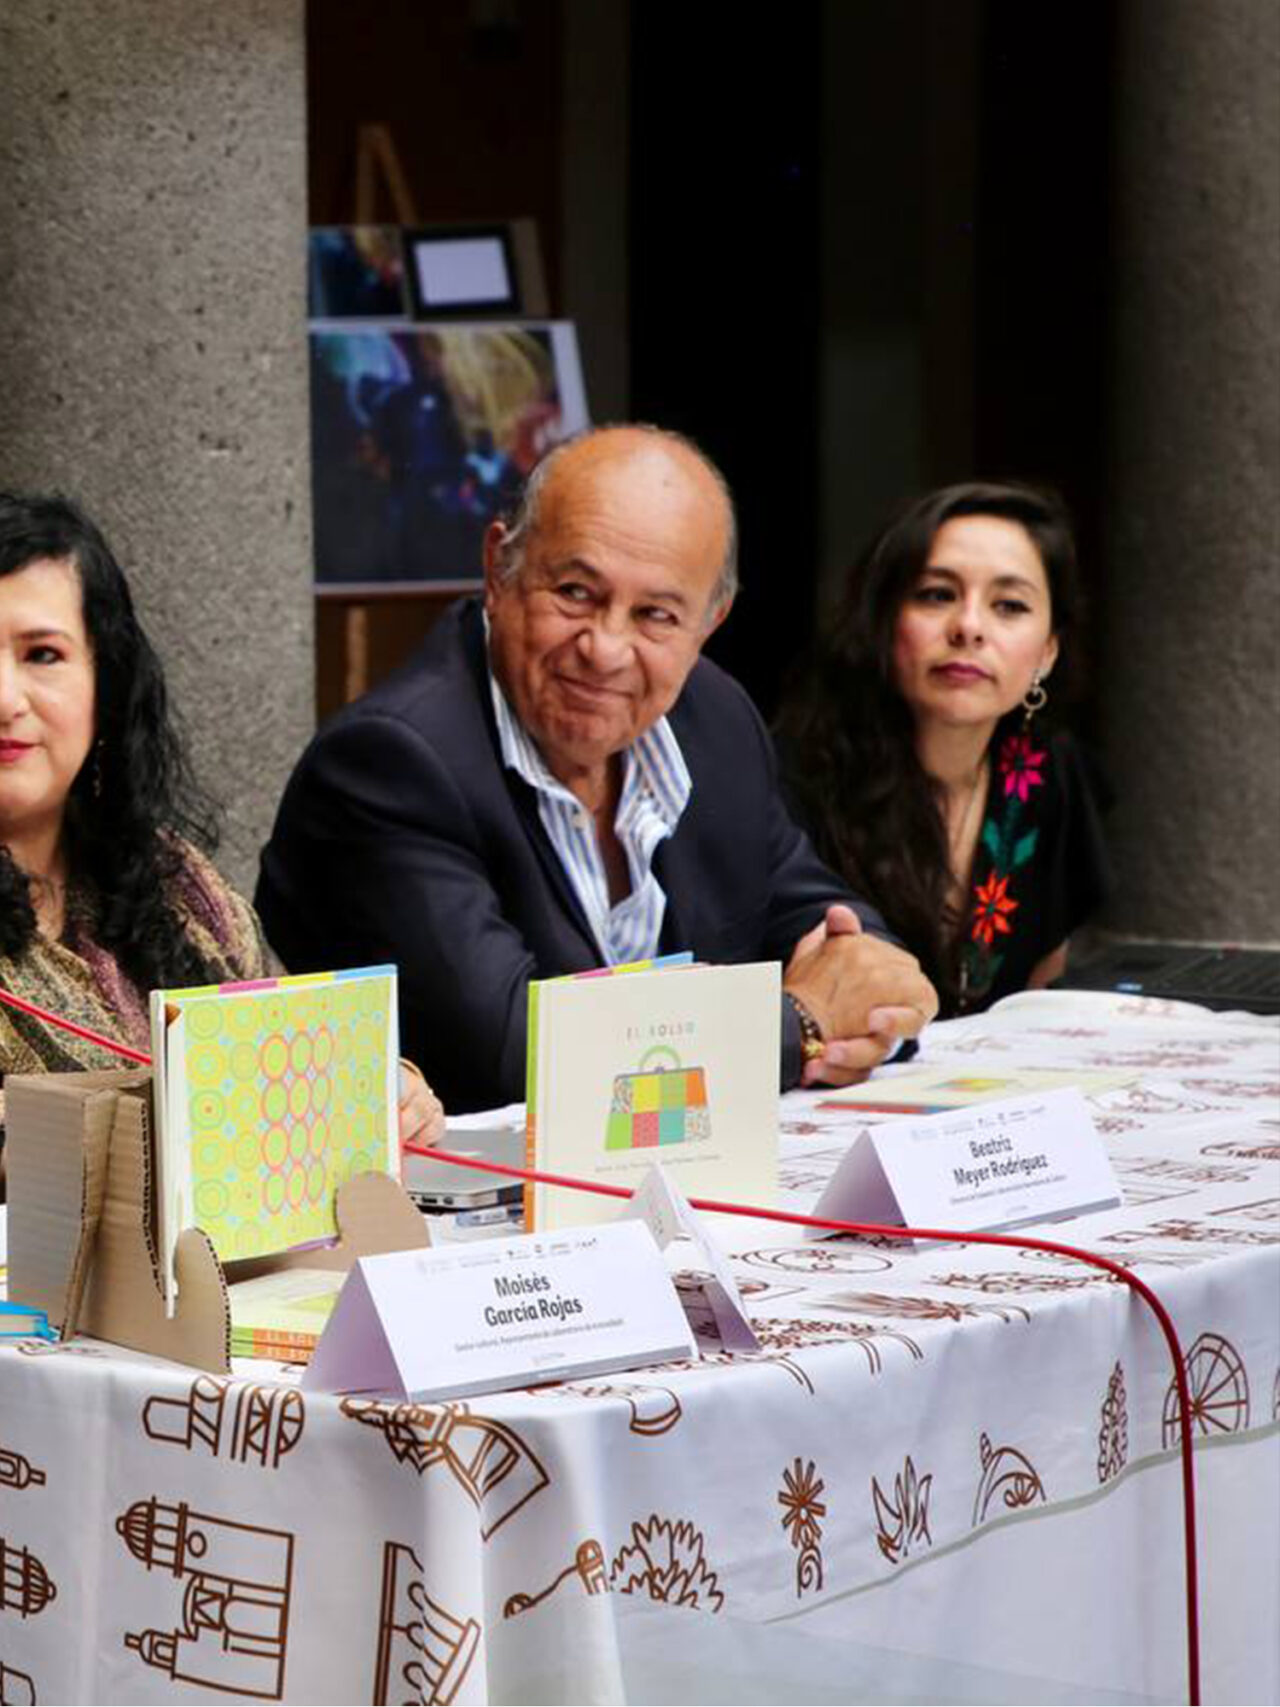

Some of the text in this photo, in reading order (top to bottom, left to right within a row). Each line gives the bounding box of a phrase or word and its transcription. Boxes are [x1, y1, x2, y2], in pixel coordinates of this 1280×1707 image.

[969, 1135, 1013, 1158] Beatriz
[953, 1166, 991, 1188] Meyer
[494, 1272, 551, 1297] Moisés
[484, 1294, 583, 1327] García Rojas
